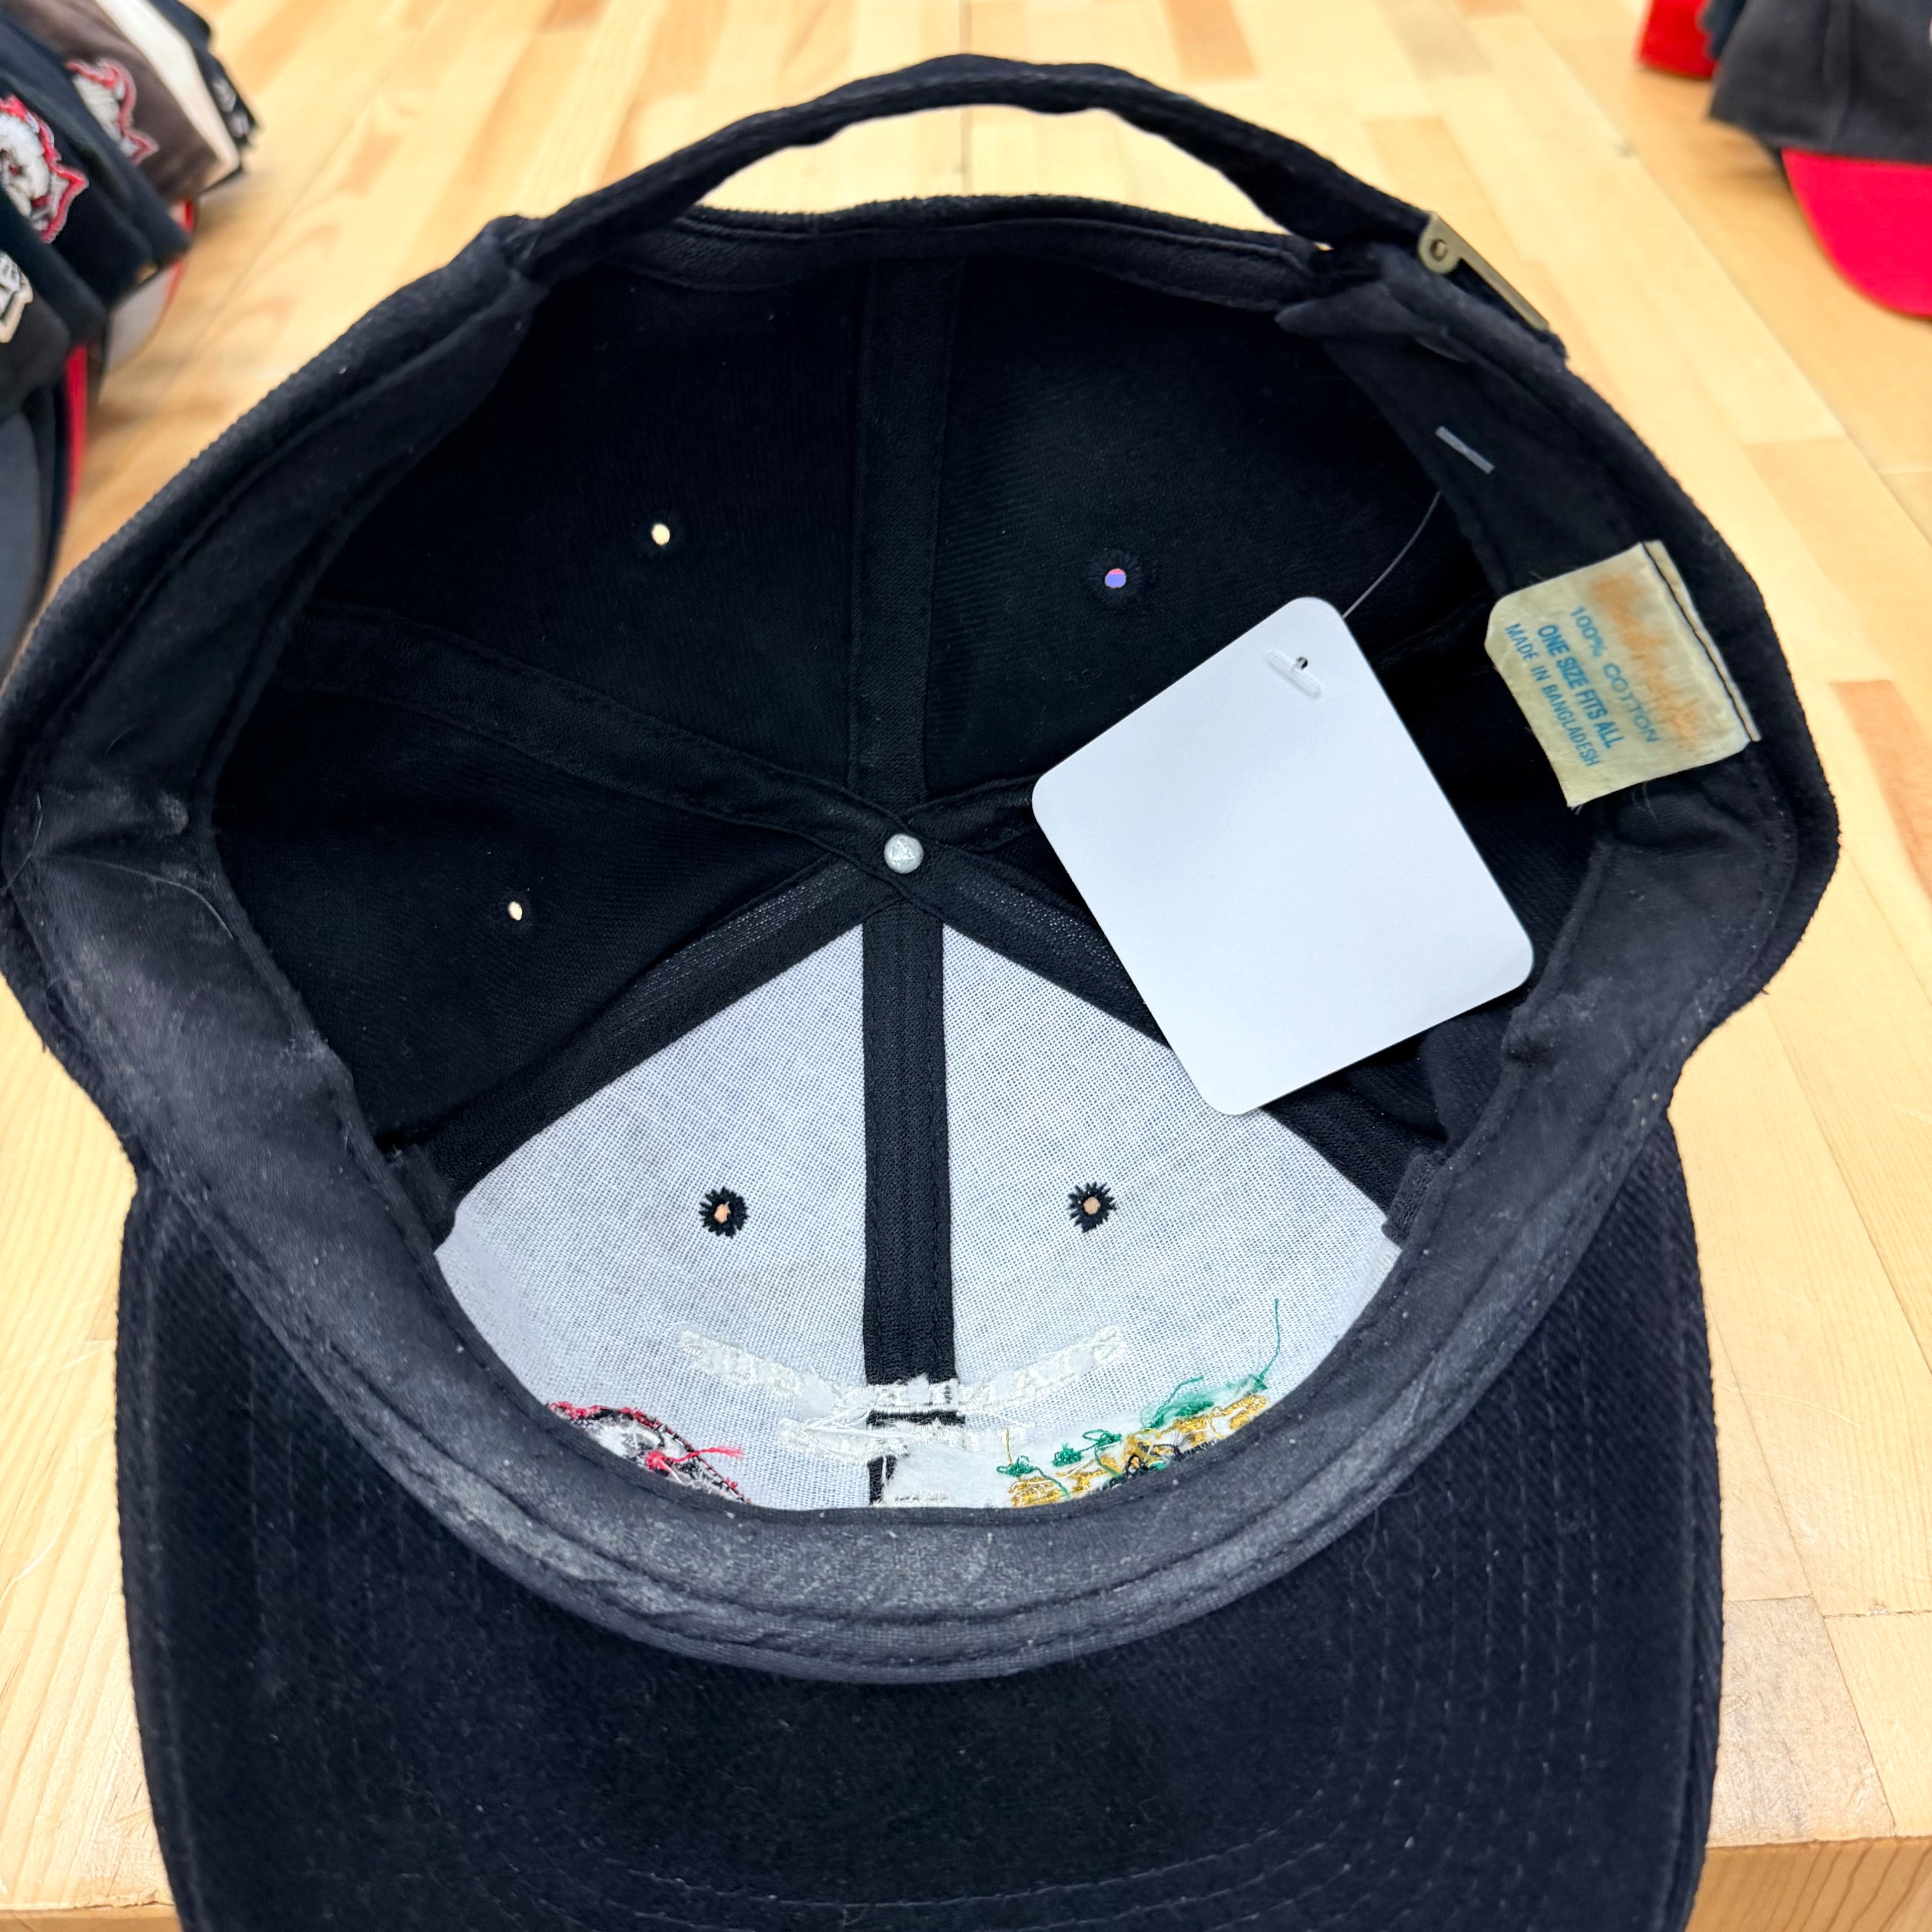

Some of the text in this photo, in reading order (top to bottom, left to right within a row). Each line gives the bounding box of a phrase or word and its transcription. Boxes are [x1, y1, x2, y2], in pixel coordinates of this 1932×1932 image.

[1505, 623, 1600, 766] MADE IN BANGLADESH
[1538, 624, 1624, 749] ONE SIZE FITS ALL
[1571, 607, 1660, 743] 100% COTTON
